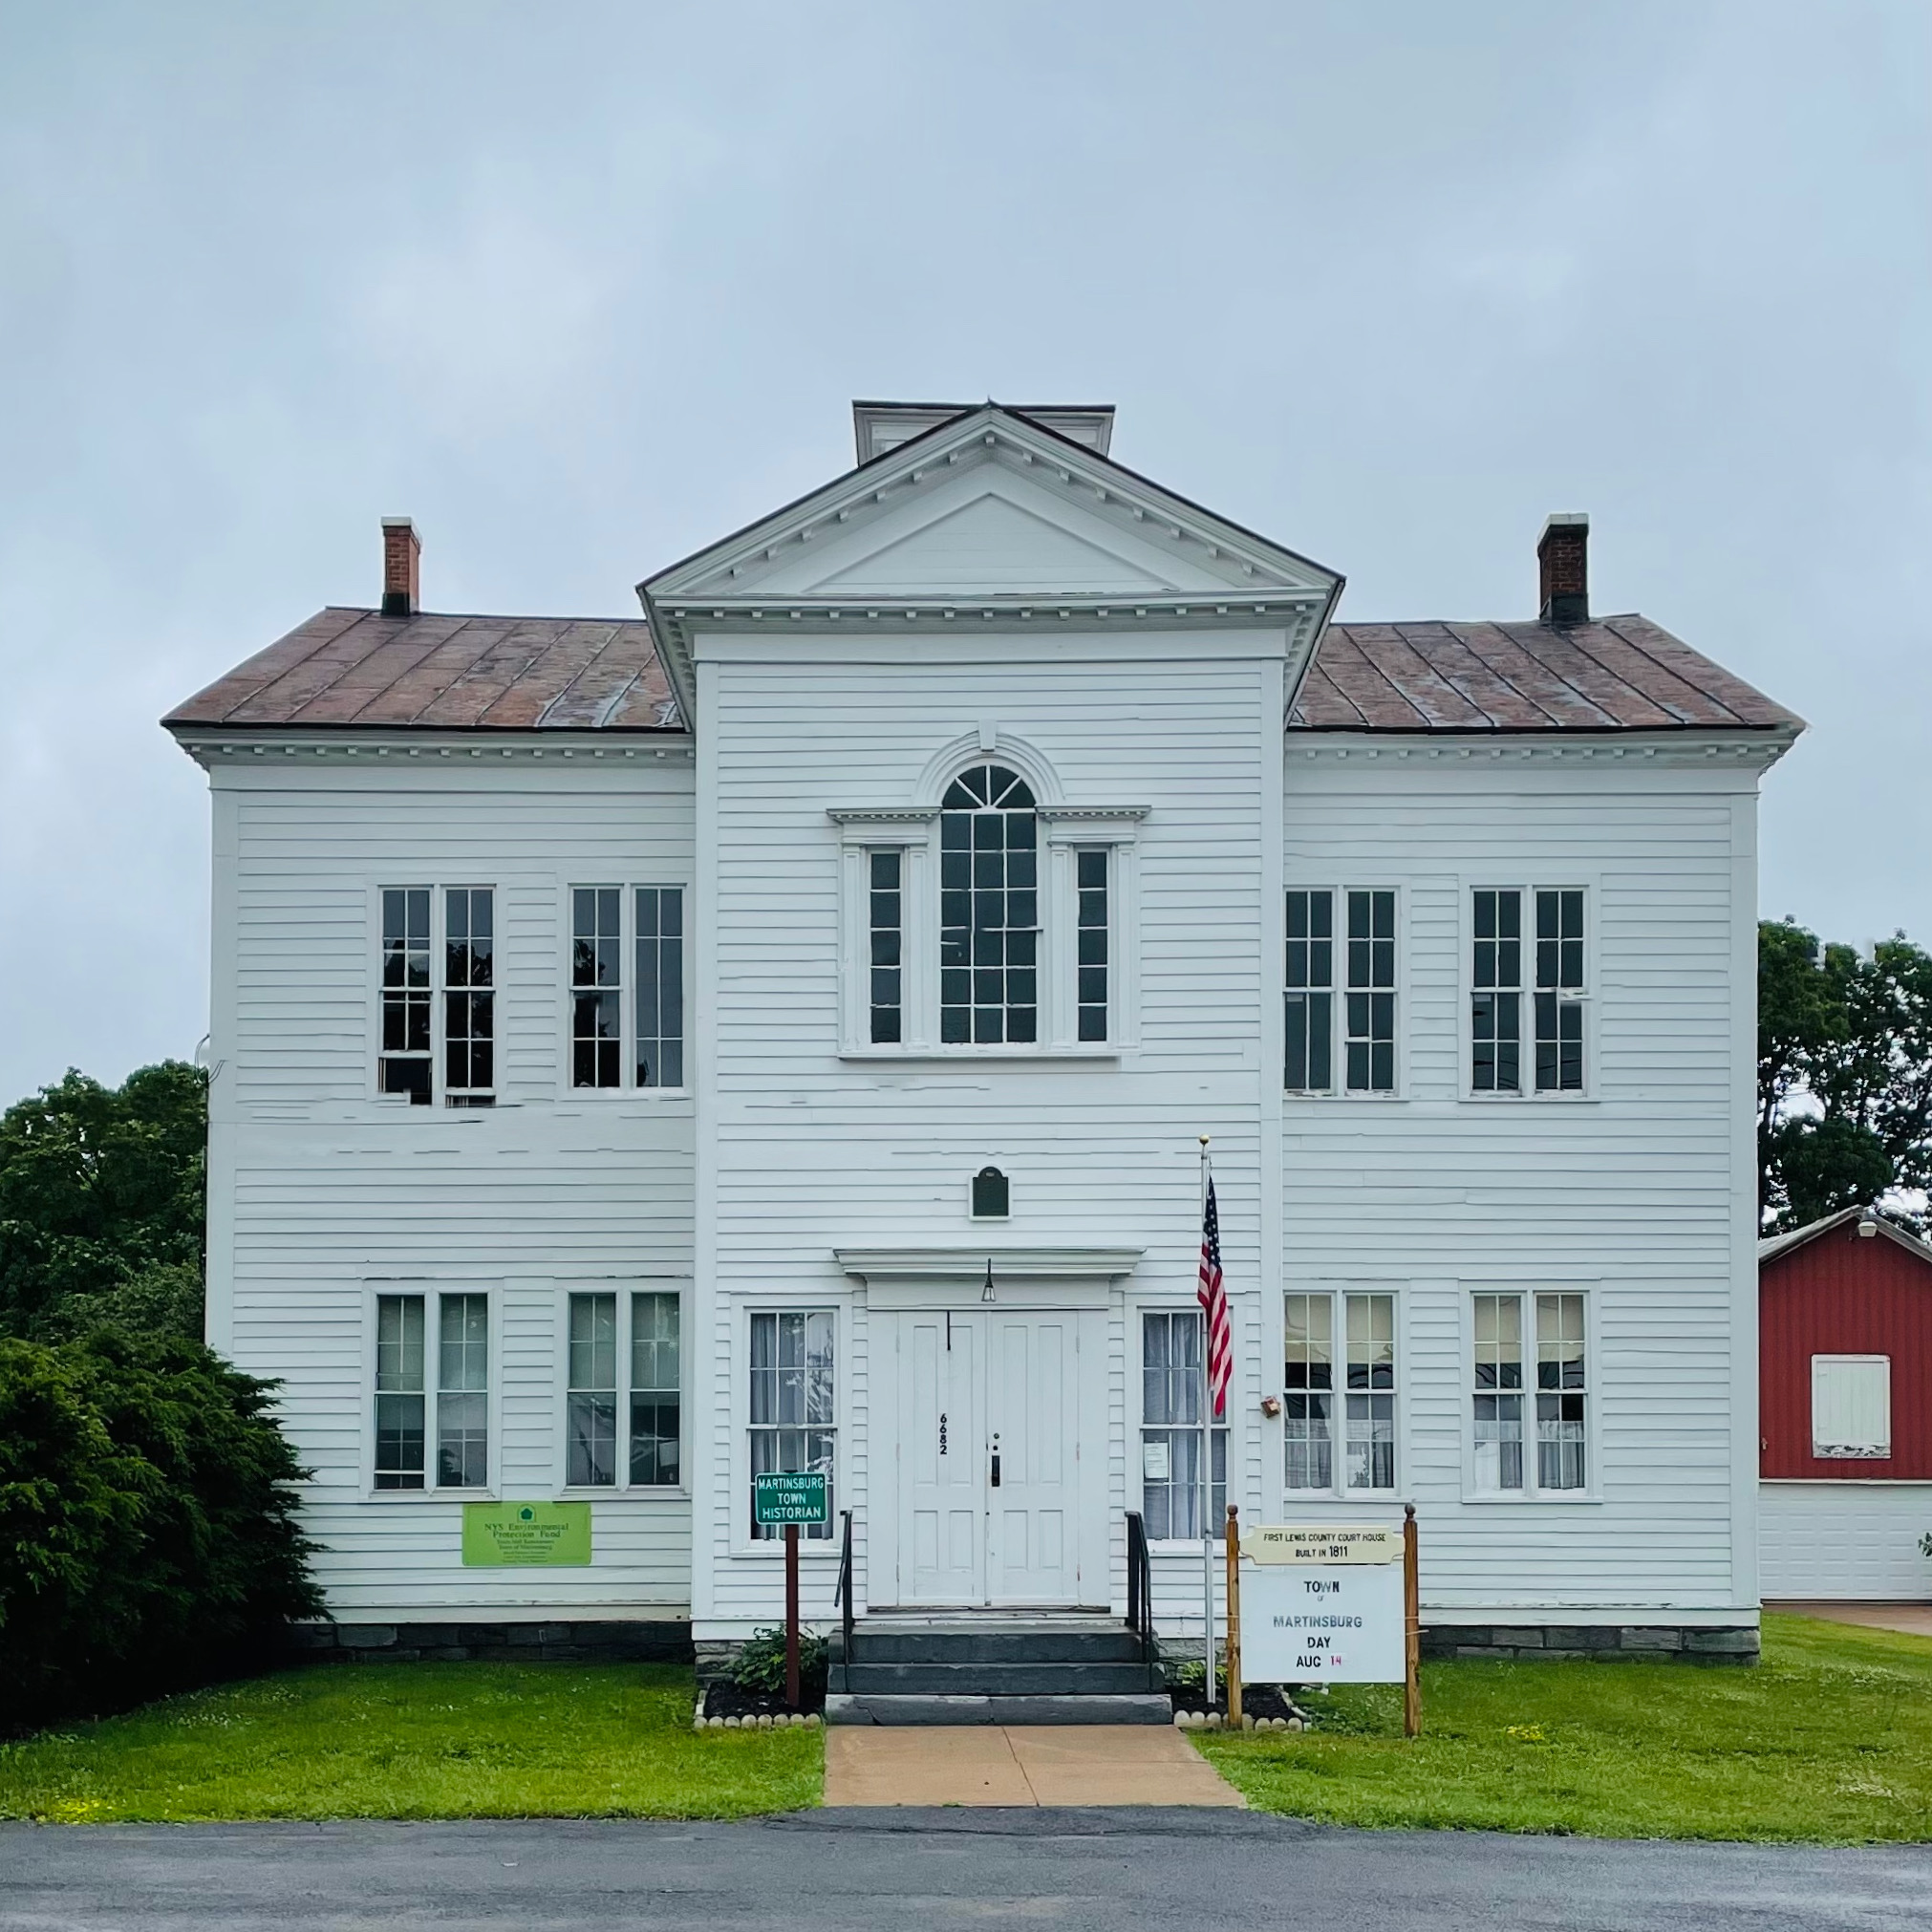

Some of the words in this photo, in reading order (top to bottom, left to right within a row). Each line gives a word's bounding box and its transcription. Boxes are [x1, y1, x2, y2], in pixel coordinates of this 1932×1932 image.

[939, 1412, 948, 1455] 6682
[758, 1477, 824, 1490] MARTINSBURG
[777, 1492, 806, 1505] TOWN
[762, 1507, 821, 1519] HISTORIAN
[1263, 1533, 1283, 1542] FIRST
[1285, 1533, 1306, 1542] LEWIS
[1308, 1533, 1336, 1542] COUNTY
[1338, 1533, 1361, 1542] COURT
[1363, 1533, 1386, 1542] HOUSE
[1295, 1549, 1317, 1557] BUILT
[1319, 1549, 1326, 1557] IN
[1329, 1545, 1348, 1557] 1811
[1303, 1580, 1340, 1593] TOWN
[1273, 1615, 1363, 1628] MARTINSBURG
[1307, 1636, 1331, 1649] DAY
[1296, 1655, 1321, 1668] AUG
[1330, 1655, 1342, 1666] 14
